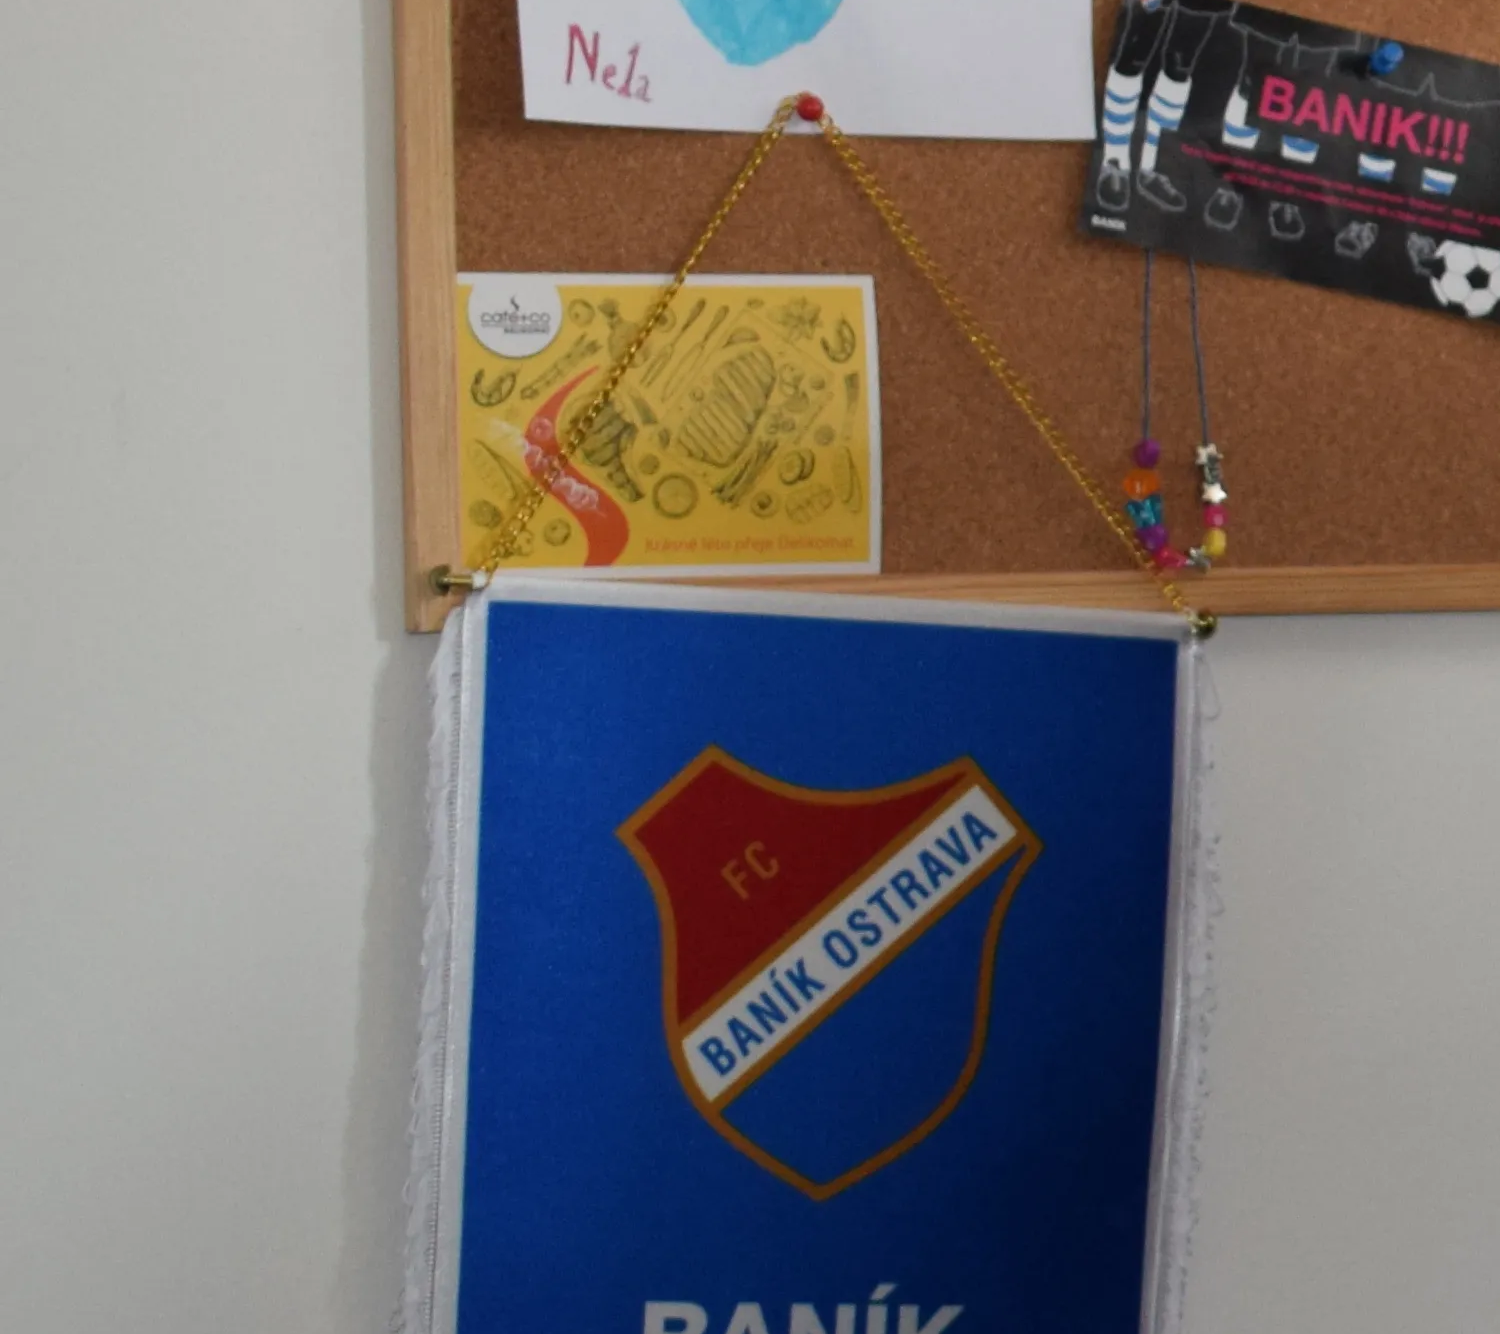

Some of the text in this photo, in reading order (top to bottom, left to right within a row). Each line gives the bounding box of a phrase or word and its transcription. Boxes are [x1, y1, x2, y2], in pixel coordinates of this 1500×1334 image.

[1257, 74, 1471, 165] BANIK!!!
[719, 839, 781, 902] FC
[698, 808, 999, 1079] BANÍK OSTRAVA
